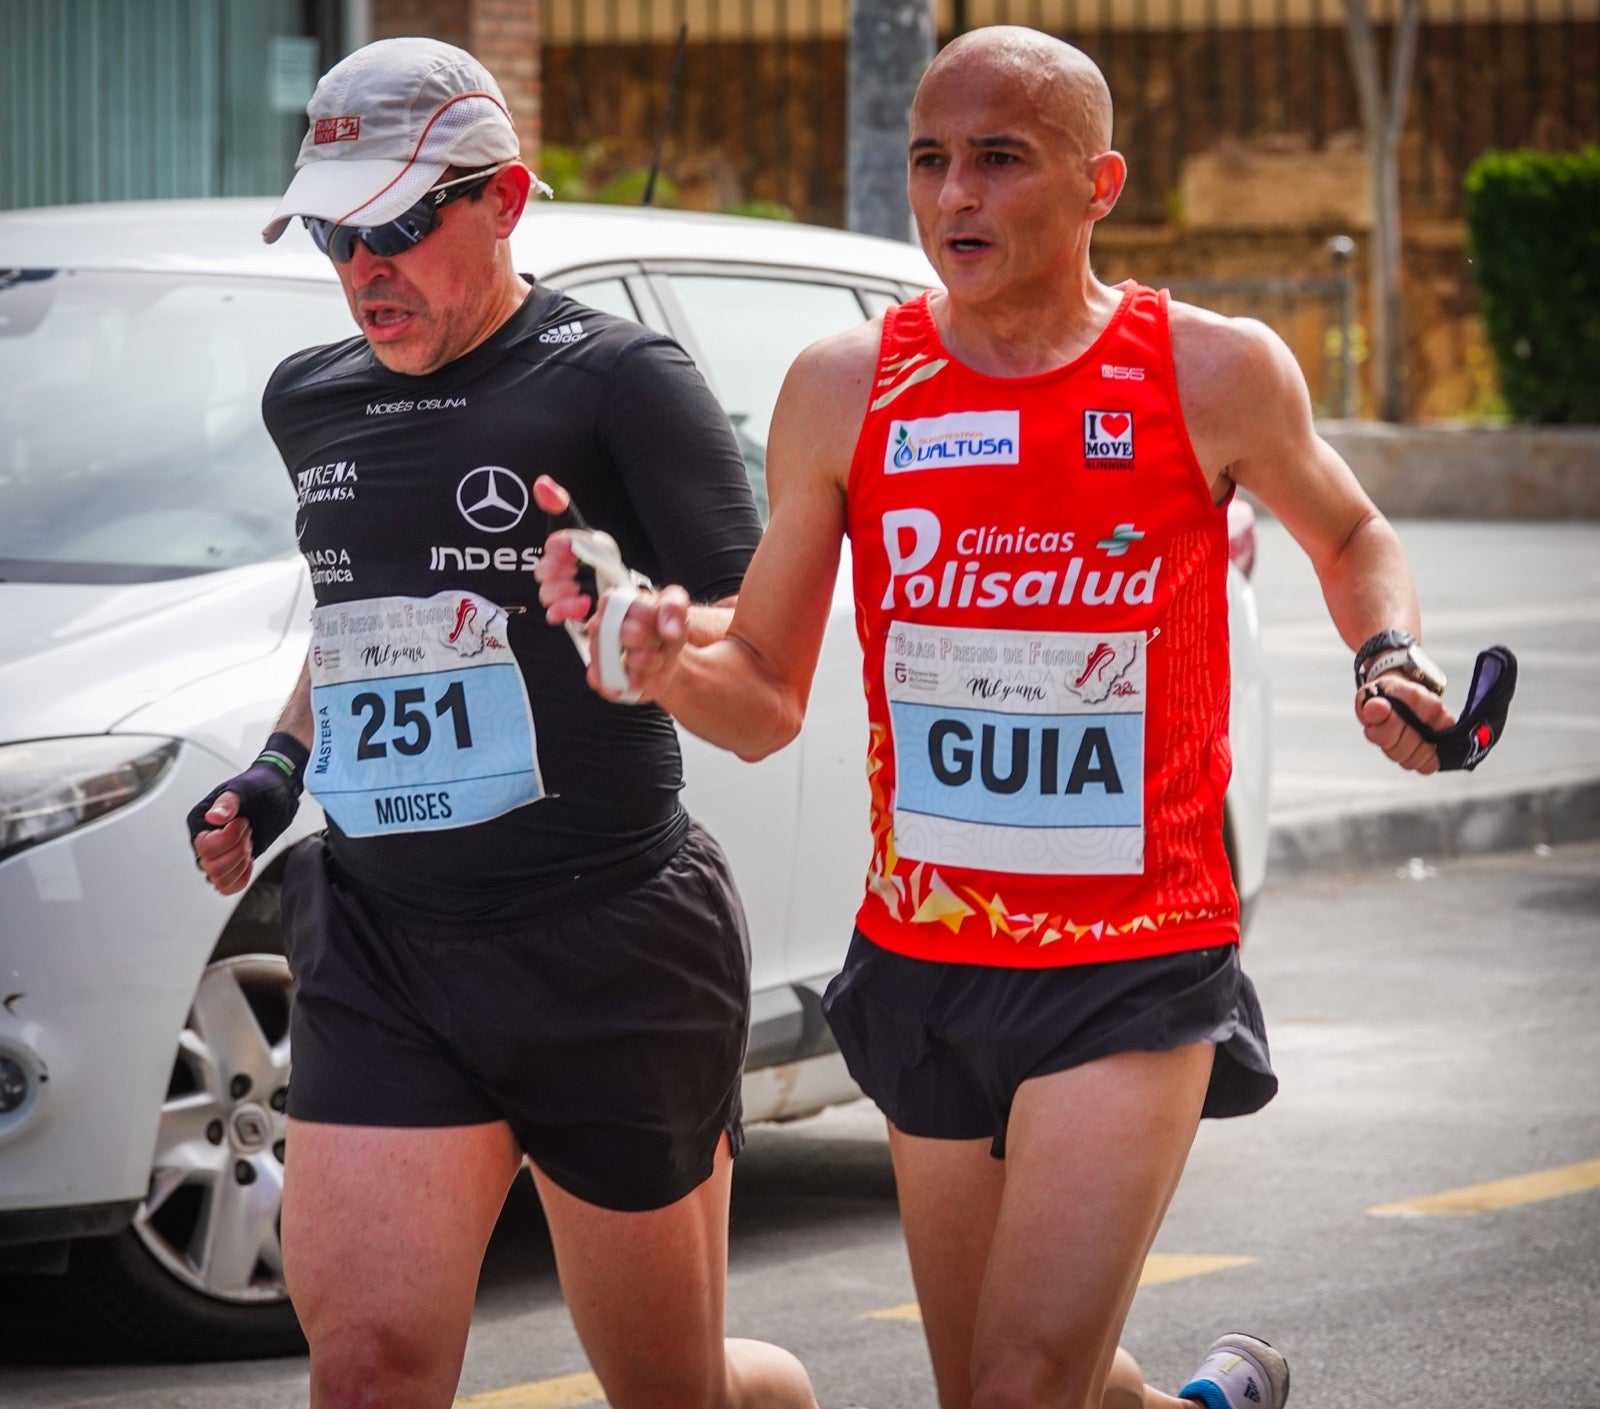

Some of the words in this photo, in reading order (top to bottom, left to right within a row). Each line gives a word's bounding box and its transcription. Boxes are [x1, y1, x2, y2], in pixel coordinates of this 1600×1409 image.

[366, 400, 415, 415] MOISÉS
[417, 398, 467, 410] OSUNA
[1088, 414, 1097, 440] I
[917, 438, 1013, 462] VALTUSA
[1086, 442, 1132, 456] MOVE
[956, 526, 1076, 555] Clínicas
[881, 507, 1162, 610] Polisalud
[319, 705, 329, 716] A
[351, 681, 473, 761] 251
[314, 719, 332, 774] MASTER
[928, 719, 1124, 795] GUIA
[374, 792, 453, 825] MOISES
